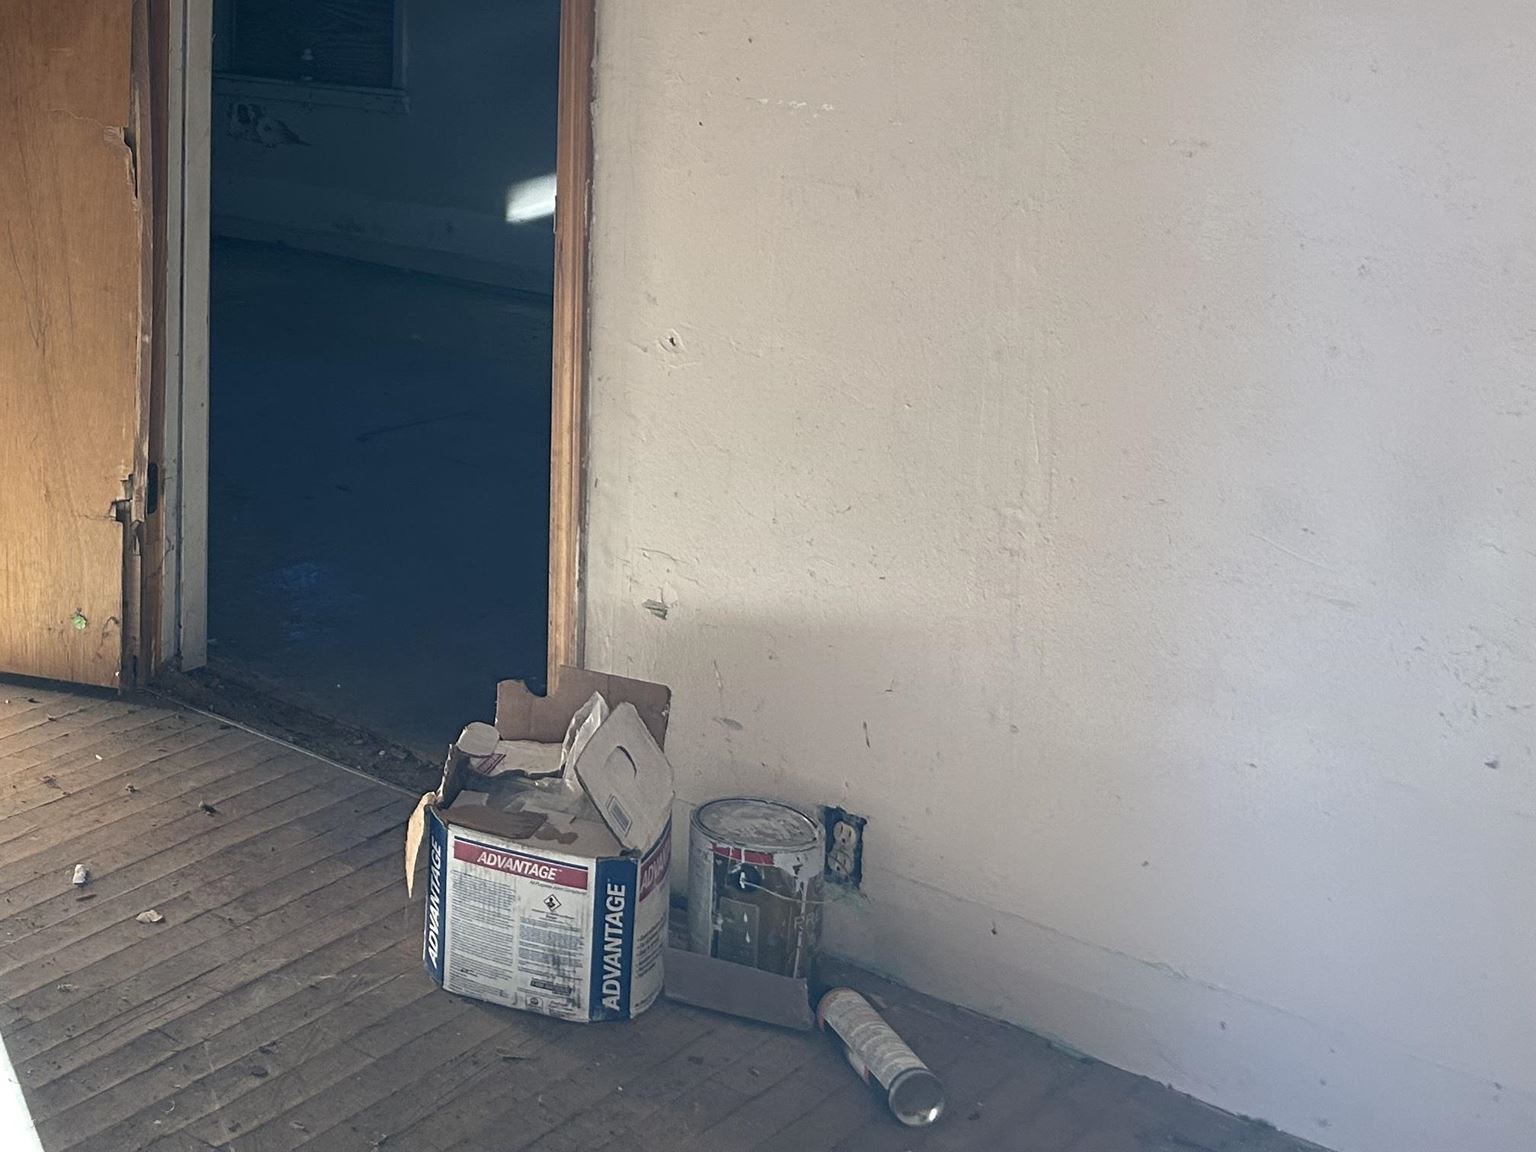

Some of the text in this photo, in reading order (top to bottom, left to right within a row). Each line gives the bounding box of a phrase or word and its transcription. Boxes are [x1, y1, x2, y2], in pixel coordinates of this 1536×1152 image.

[427, 835, 442, 969] ADVANTAGE
[477, 851, 558, 881] ADVANTAGE
[601, 882, 626, 1012] ADVANTAGE
